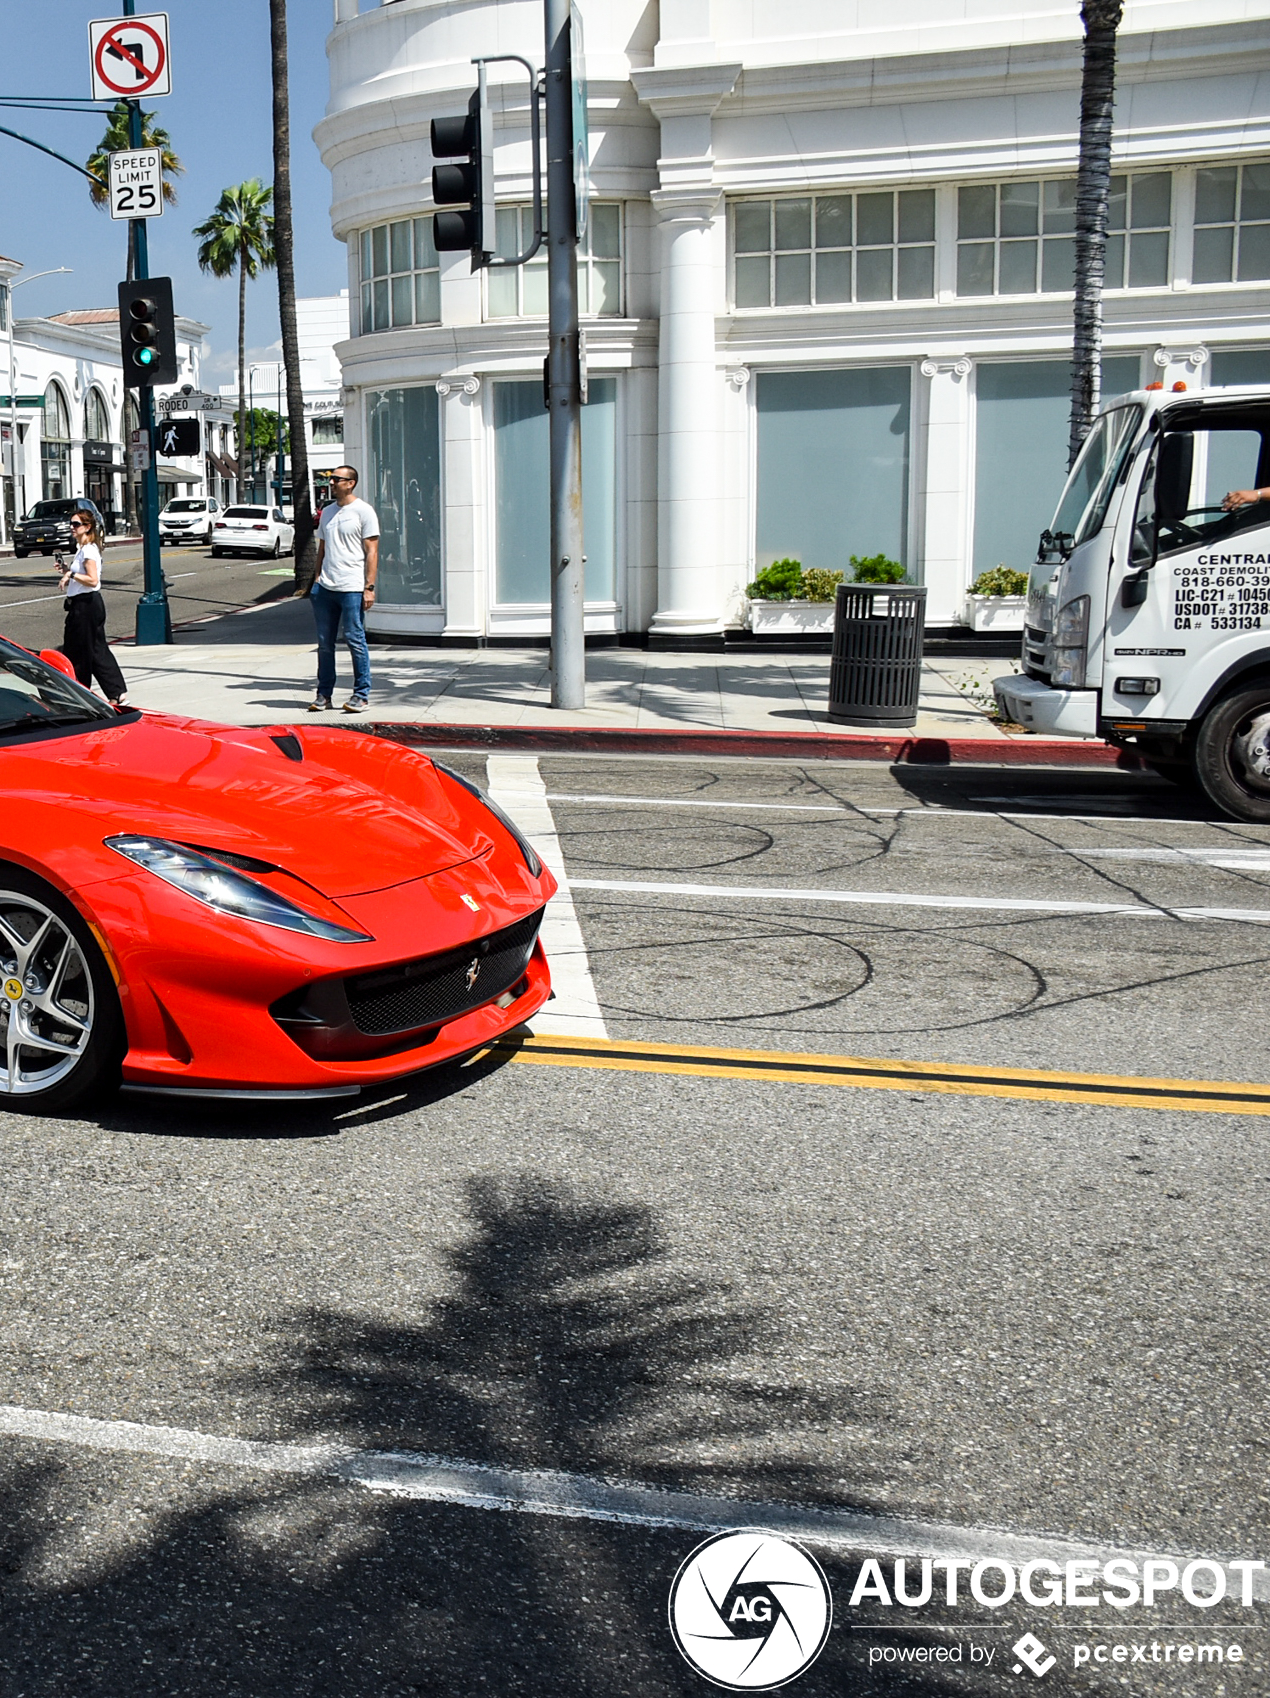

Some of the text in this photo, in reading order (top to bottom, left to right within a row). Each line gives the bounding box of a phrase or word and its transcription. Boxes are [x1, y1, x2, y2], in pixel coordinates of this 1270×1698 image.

[114, 157, 156, 170] SPEED
[118, 171, 151, 183] LIMIT
[116, 184, 156, 211] 25
[158, 400, 188, 411] RODEO
[1174, 566, 1270, 576] COAST DEMOLI
[1175, 589, 1224, 602] LIC-C21
[1227, 593, 1235, 601] #
[1229, 602, 1270, 615] 31738
[1174, 617, 1191, 630] CA
[1211, 617, 1261, 629] 533134
